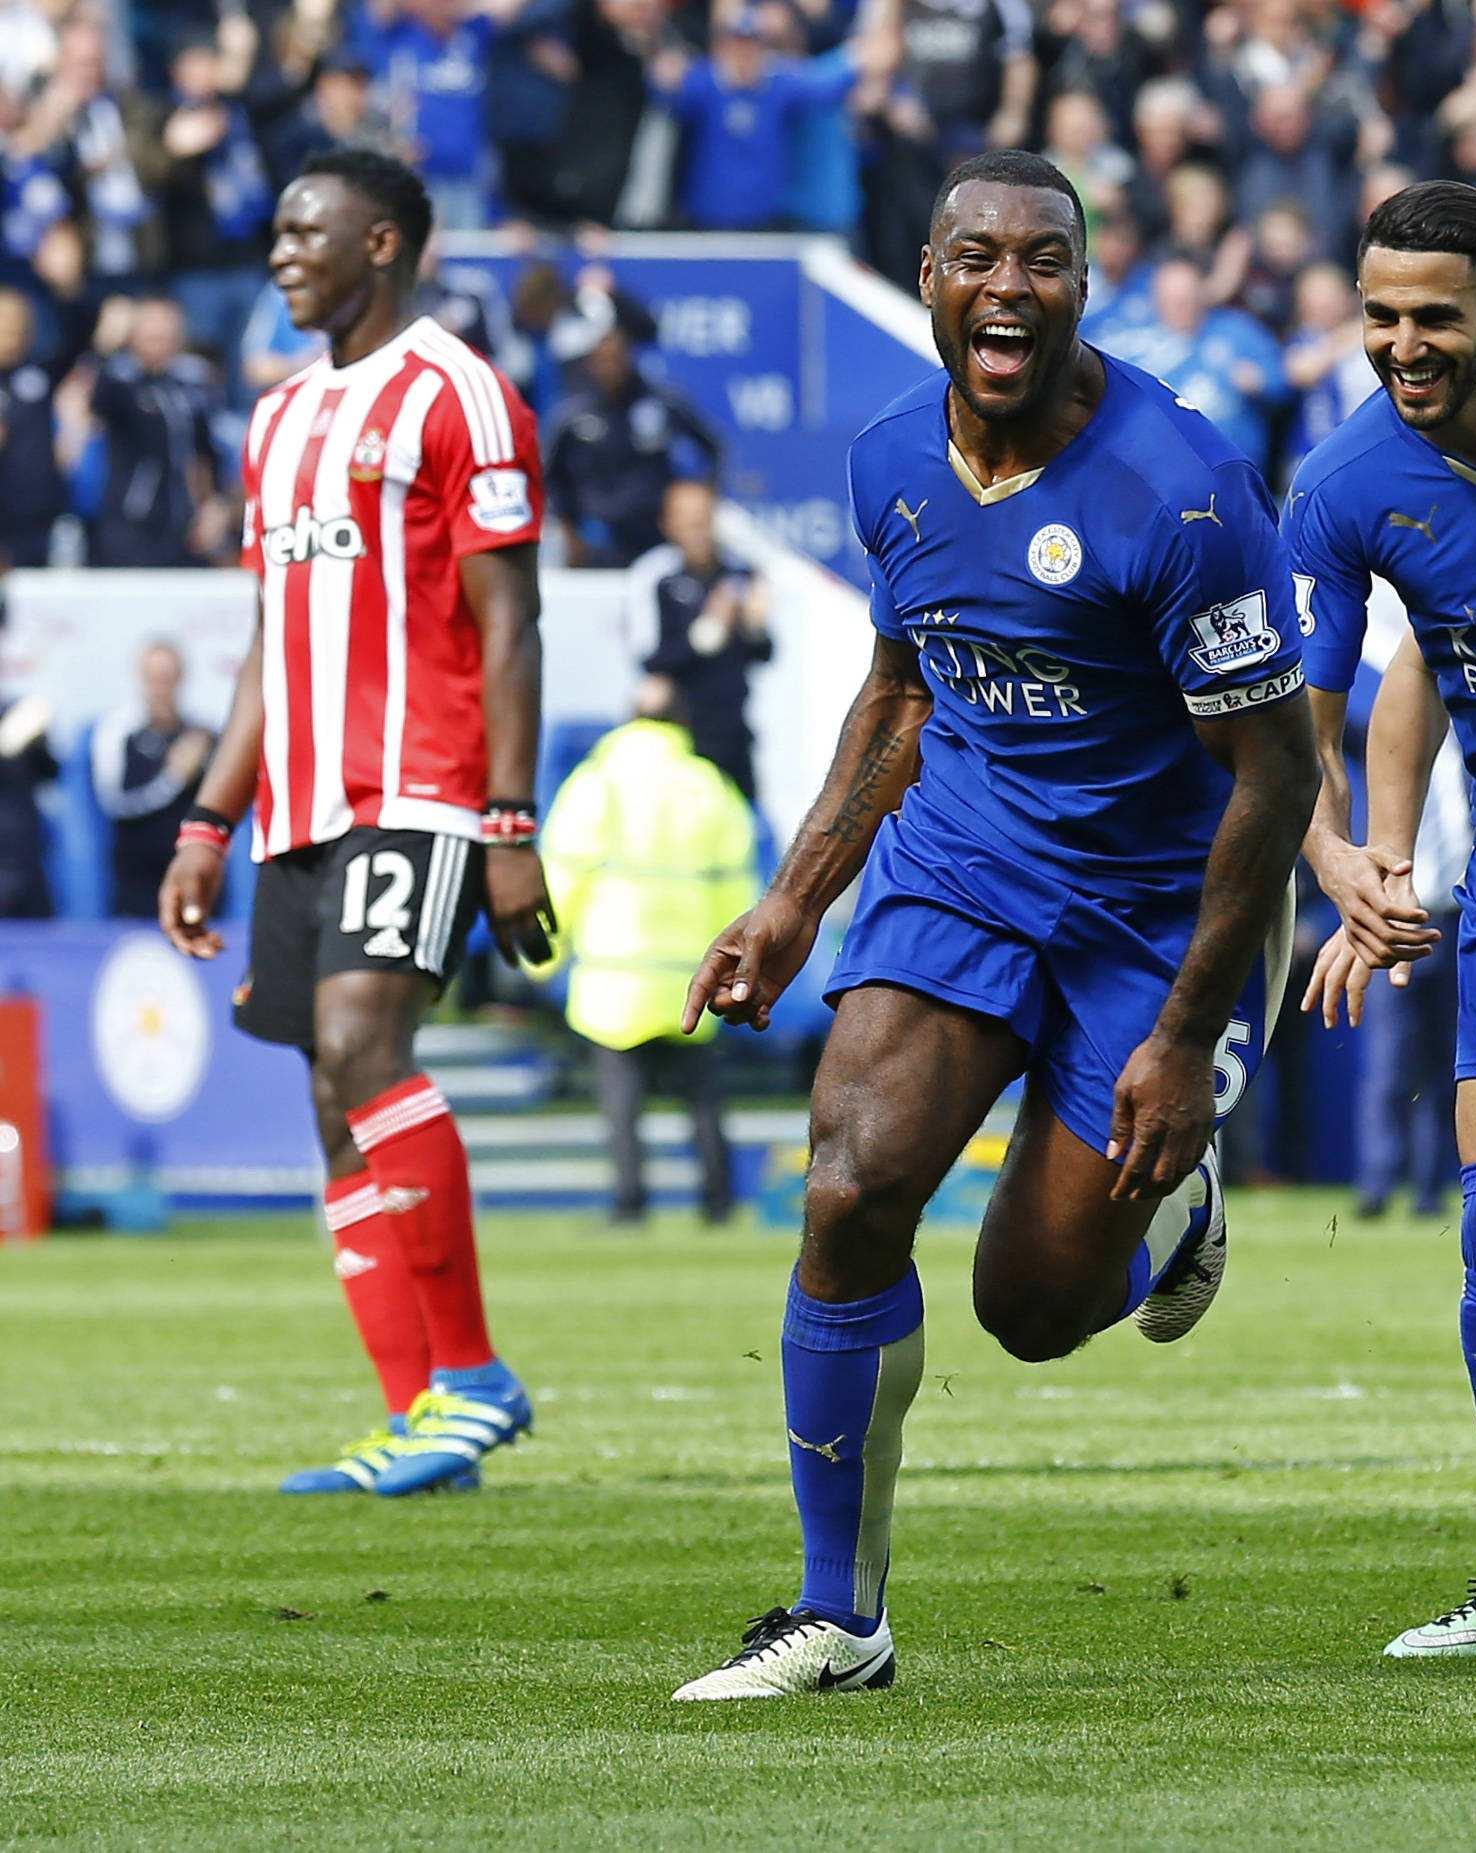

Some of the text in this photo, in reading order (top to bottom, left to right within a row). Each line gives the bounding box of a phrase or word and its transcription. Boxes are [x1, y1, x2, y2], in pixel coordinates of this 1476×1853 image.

[1208, 638, 1257, 660] BARCLAYS
[1246, 668, 1303, 702] CAPT
[339, 850, 415, 934] 12
[1213, 1019, 1250, 1117] 5
